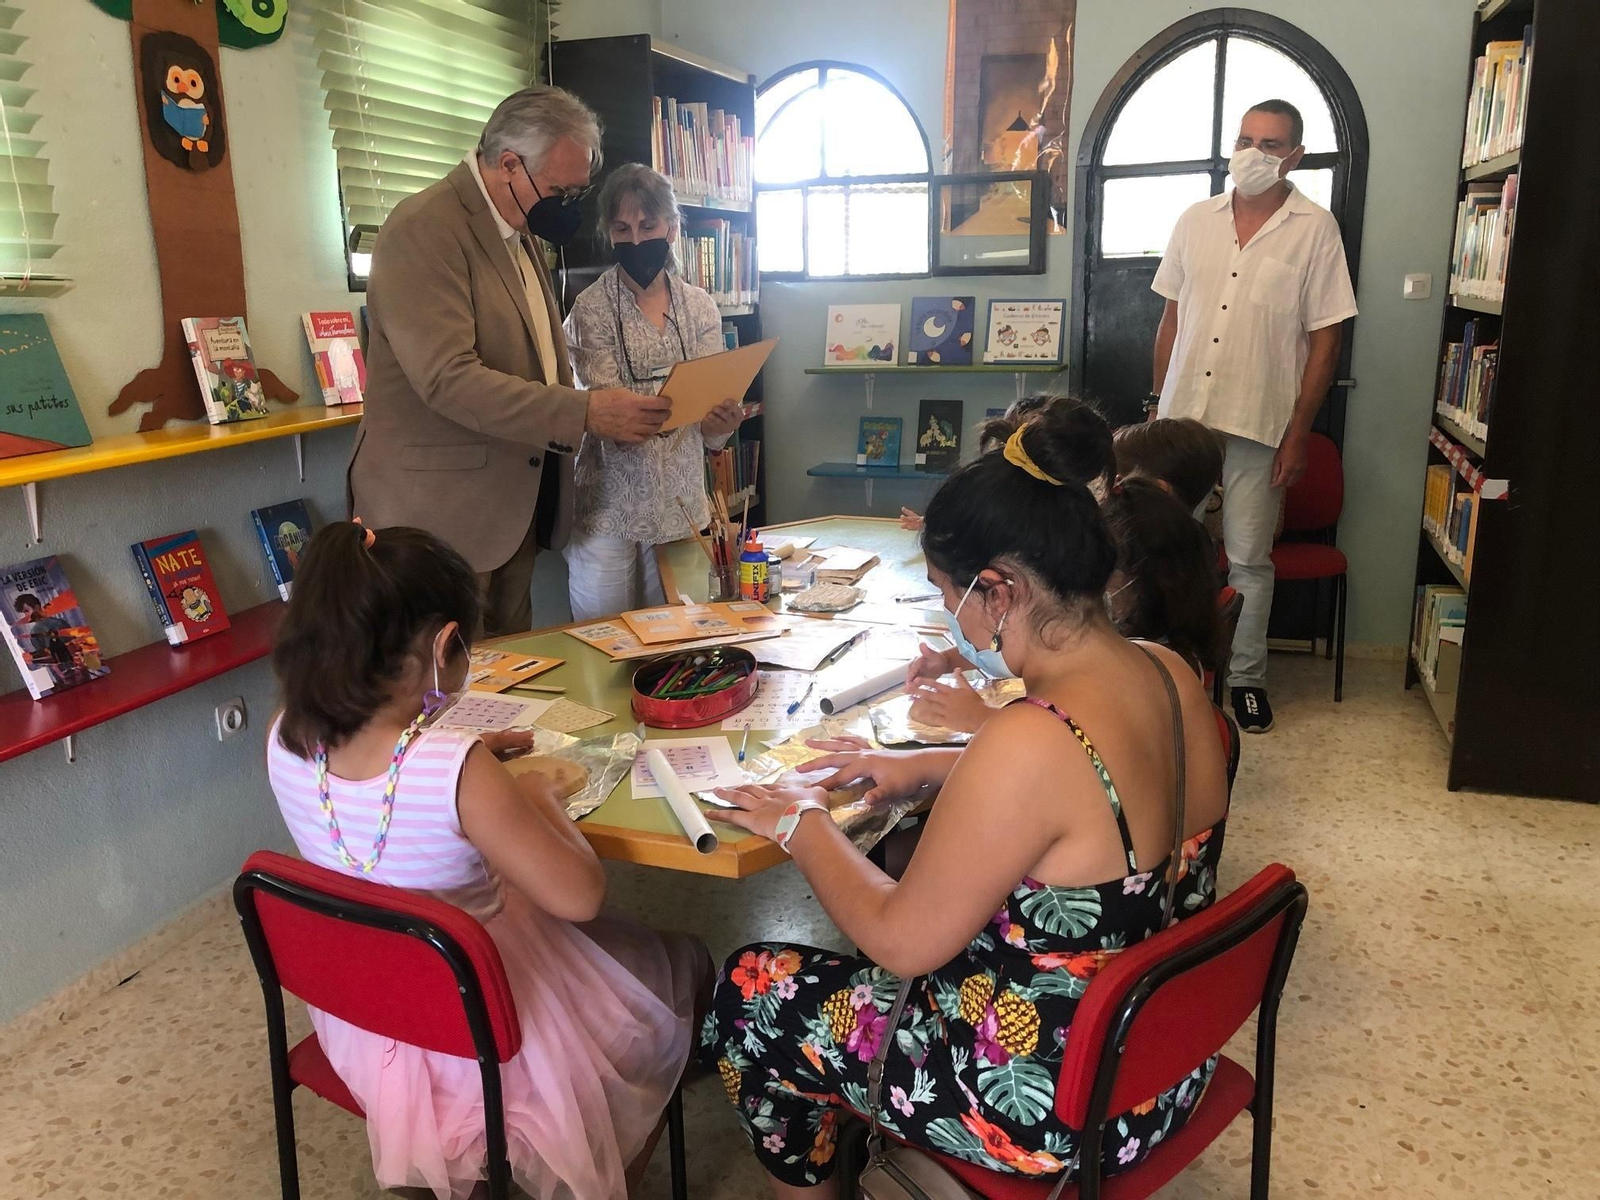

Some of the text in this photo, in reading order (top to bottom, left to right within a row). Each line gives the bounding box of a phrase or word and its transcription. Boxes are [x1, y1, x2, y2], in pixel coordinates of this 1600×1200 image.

[210, 336, 232, 345] Aventura
[6, 394, 70, 420] sus patitos
[155, 548, 202, 574] NATE
[0, 564, 47, 586] LA VERSIÓN
[16, 583, 29, 592] DE
[30, 576, 49, 588] ERIC
